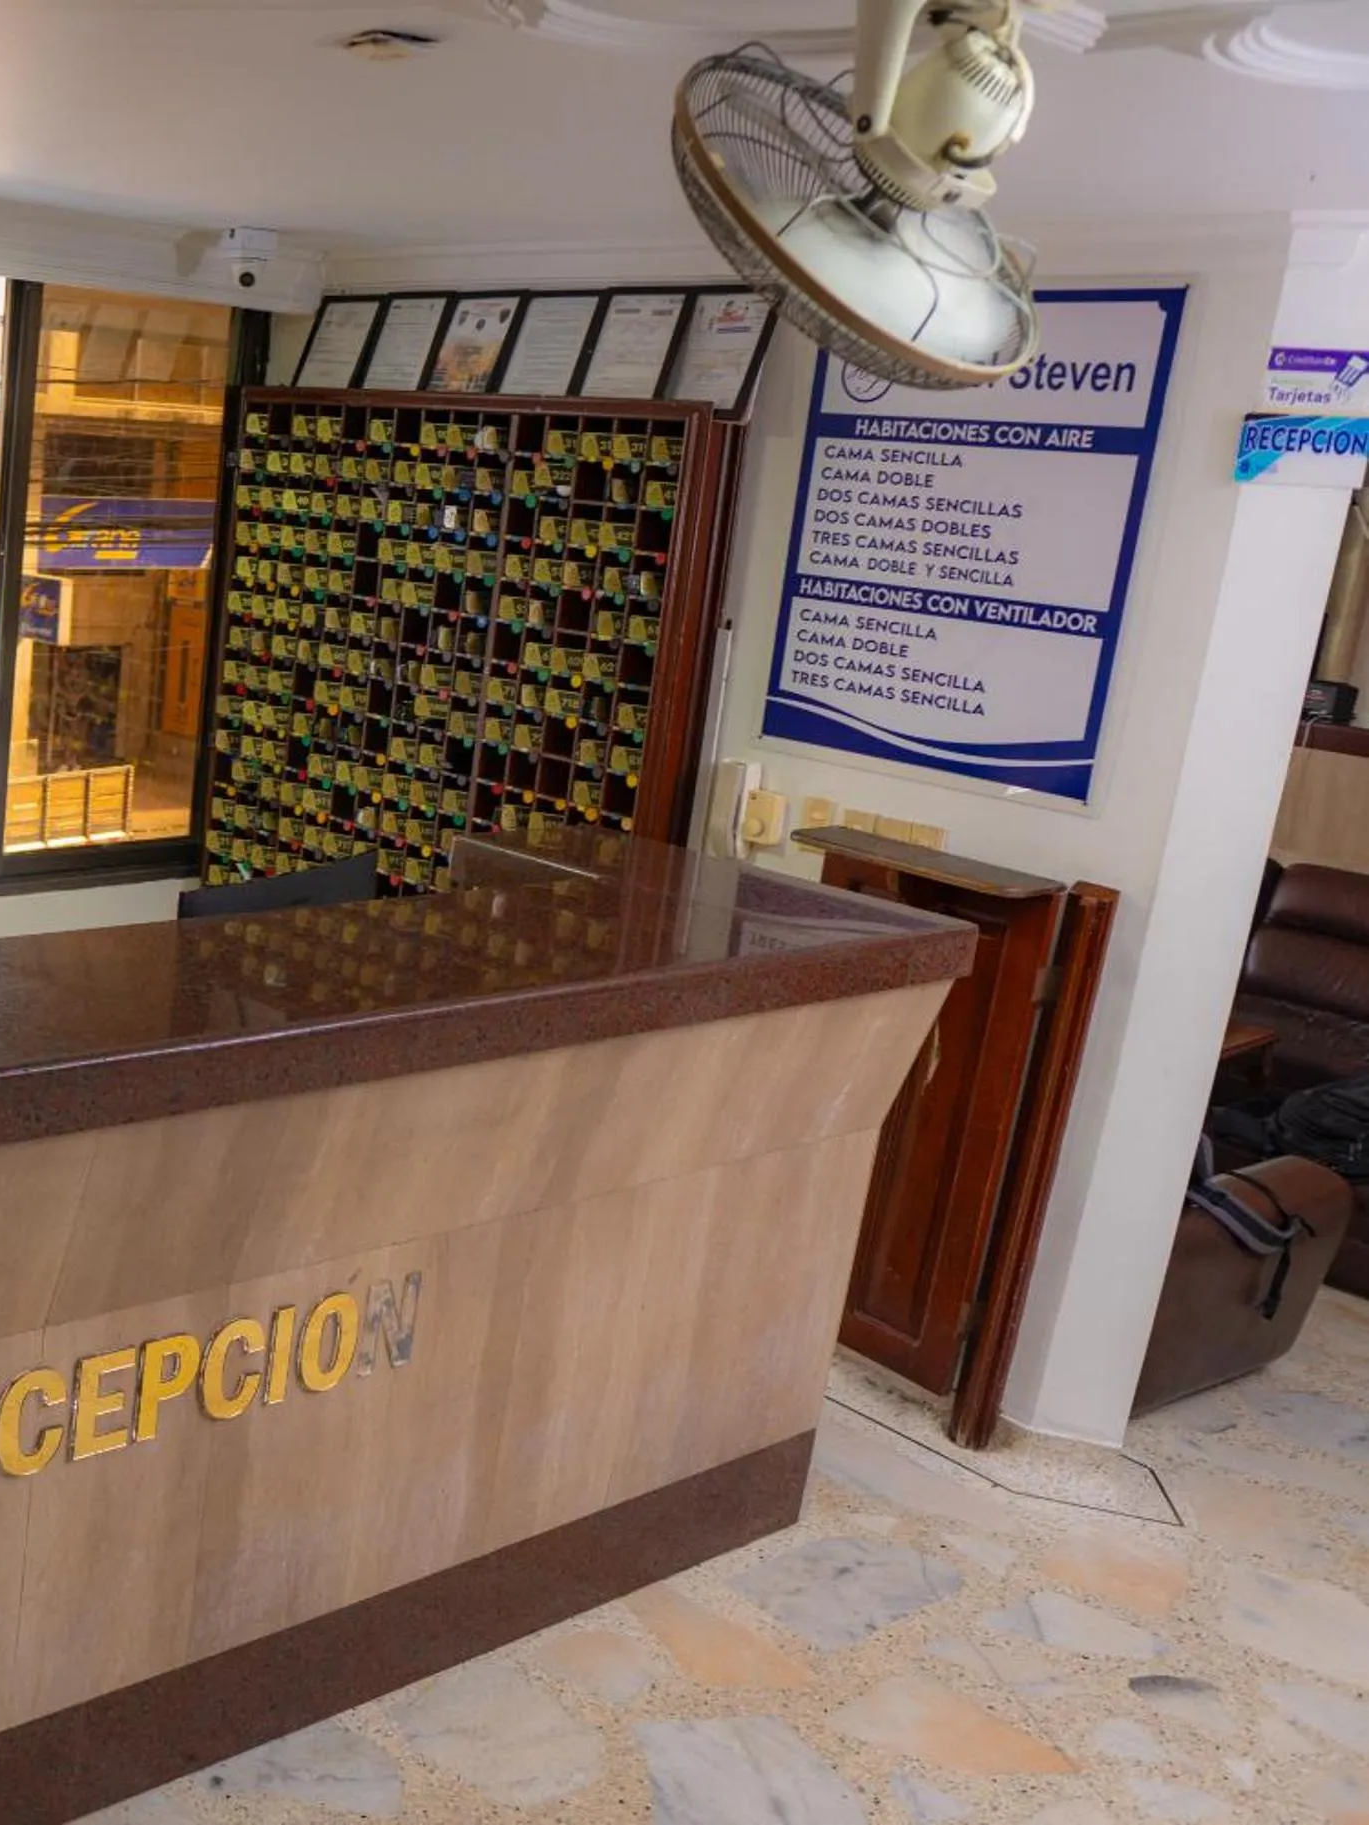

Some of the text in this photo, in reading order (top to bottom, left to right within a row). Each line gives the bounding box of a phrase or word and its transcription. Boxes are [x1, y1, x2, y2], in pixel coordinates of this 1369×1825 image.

[1009, 353, 1136, 392] Steven
[1269, 386, 1332, 405] Tarjetas
[854, 419, 1095, 448] HABITACIONES CON AIRE
[1244, 425, 1369, 455] RECEPCION
[823, 445, 963, 467] CAMA SENCILLA
[821, 467, 935, 488] CAMA DOBLE
[816, 489, 1024, 518] DOS CAMAS SENCILLAS
[813, 510, 992, 539] DOS CAMAS DOBLES
[811, 530, 1020, 565] TRES CAMAS SENCILLAS
[809, 551, 1014, 587] CAMA DOBLE Y SENCILLA
[799, 579, 1098, 634] HABITACIONES CON VENTILADOR
[799, 609, 937, 641] CAMA SENCILLA
[797, 629, 910, 659] CAMA DOBLE
[793, 650, 986, 694] DOS CAMAS SENCILLA
[790, 670, 986, 717] TRES CAMAS SENCILLA
